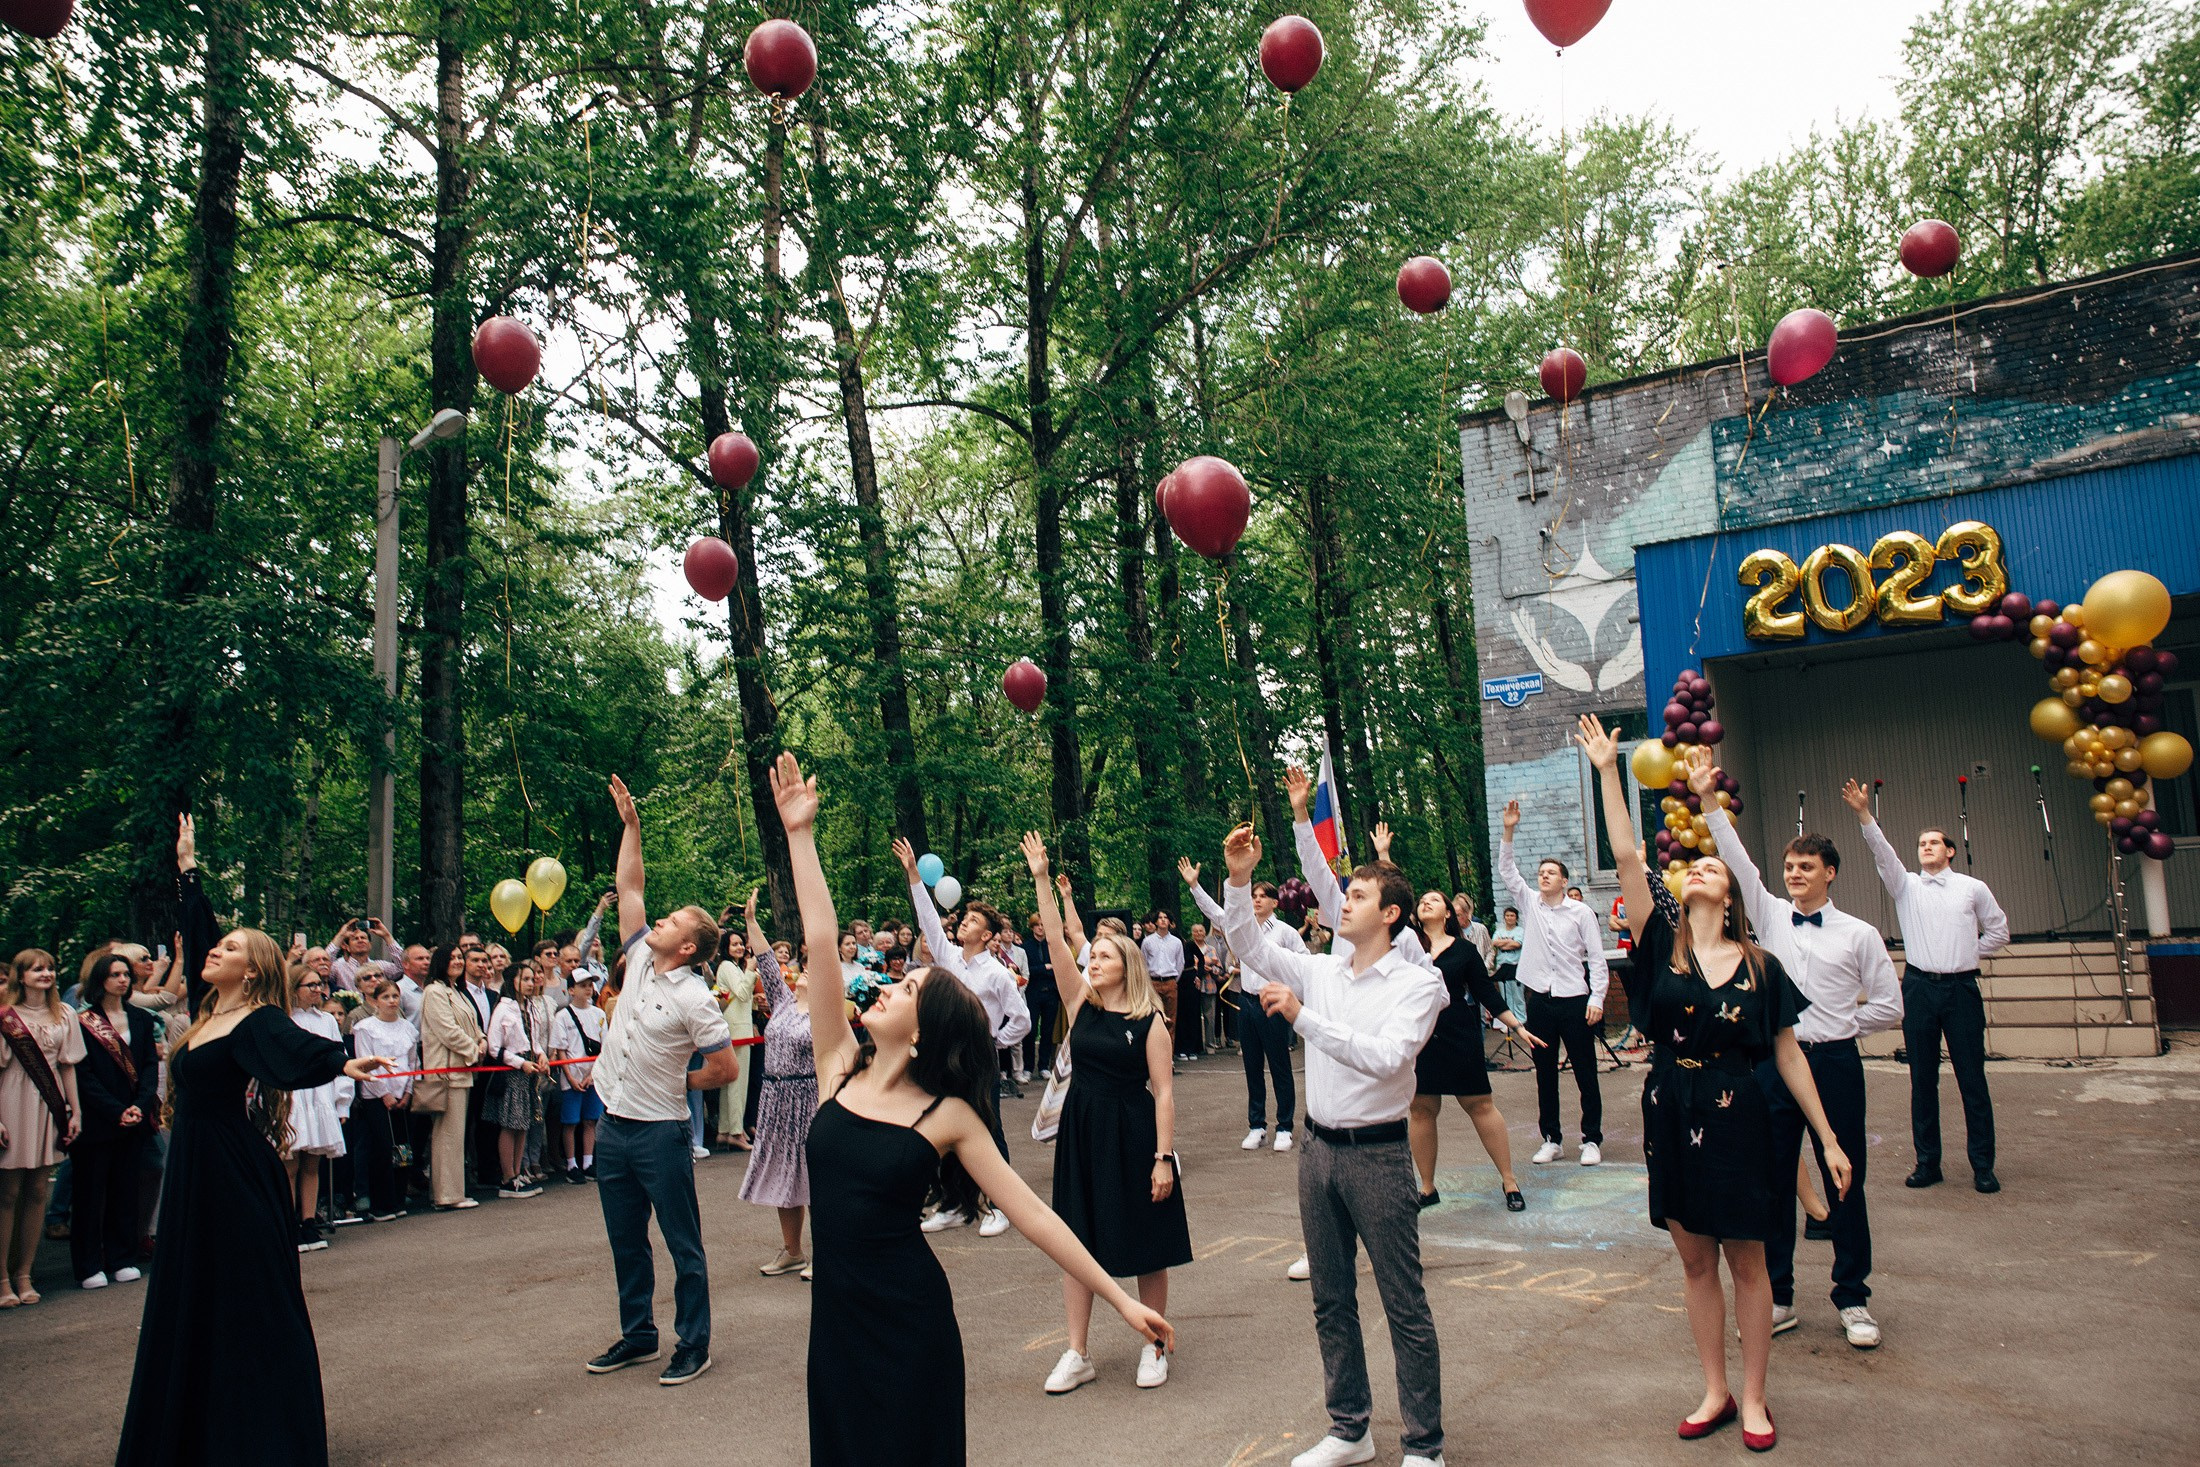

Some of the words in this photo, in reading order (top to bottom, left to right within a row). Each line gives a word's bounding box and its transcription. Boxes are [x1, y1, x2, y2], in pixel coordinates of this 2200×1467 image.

[1737, 520, 2008, 640] 2023
[1485, 679, 1540, 694] Техническая
[1507, 691, 1519, 702] 22
